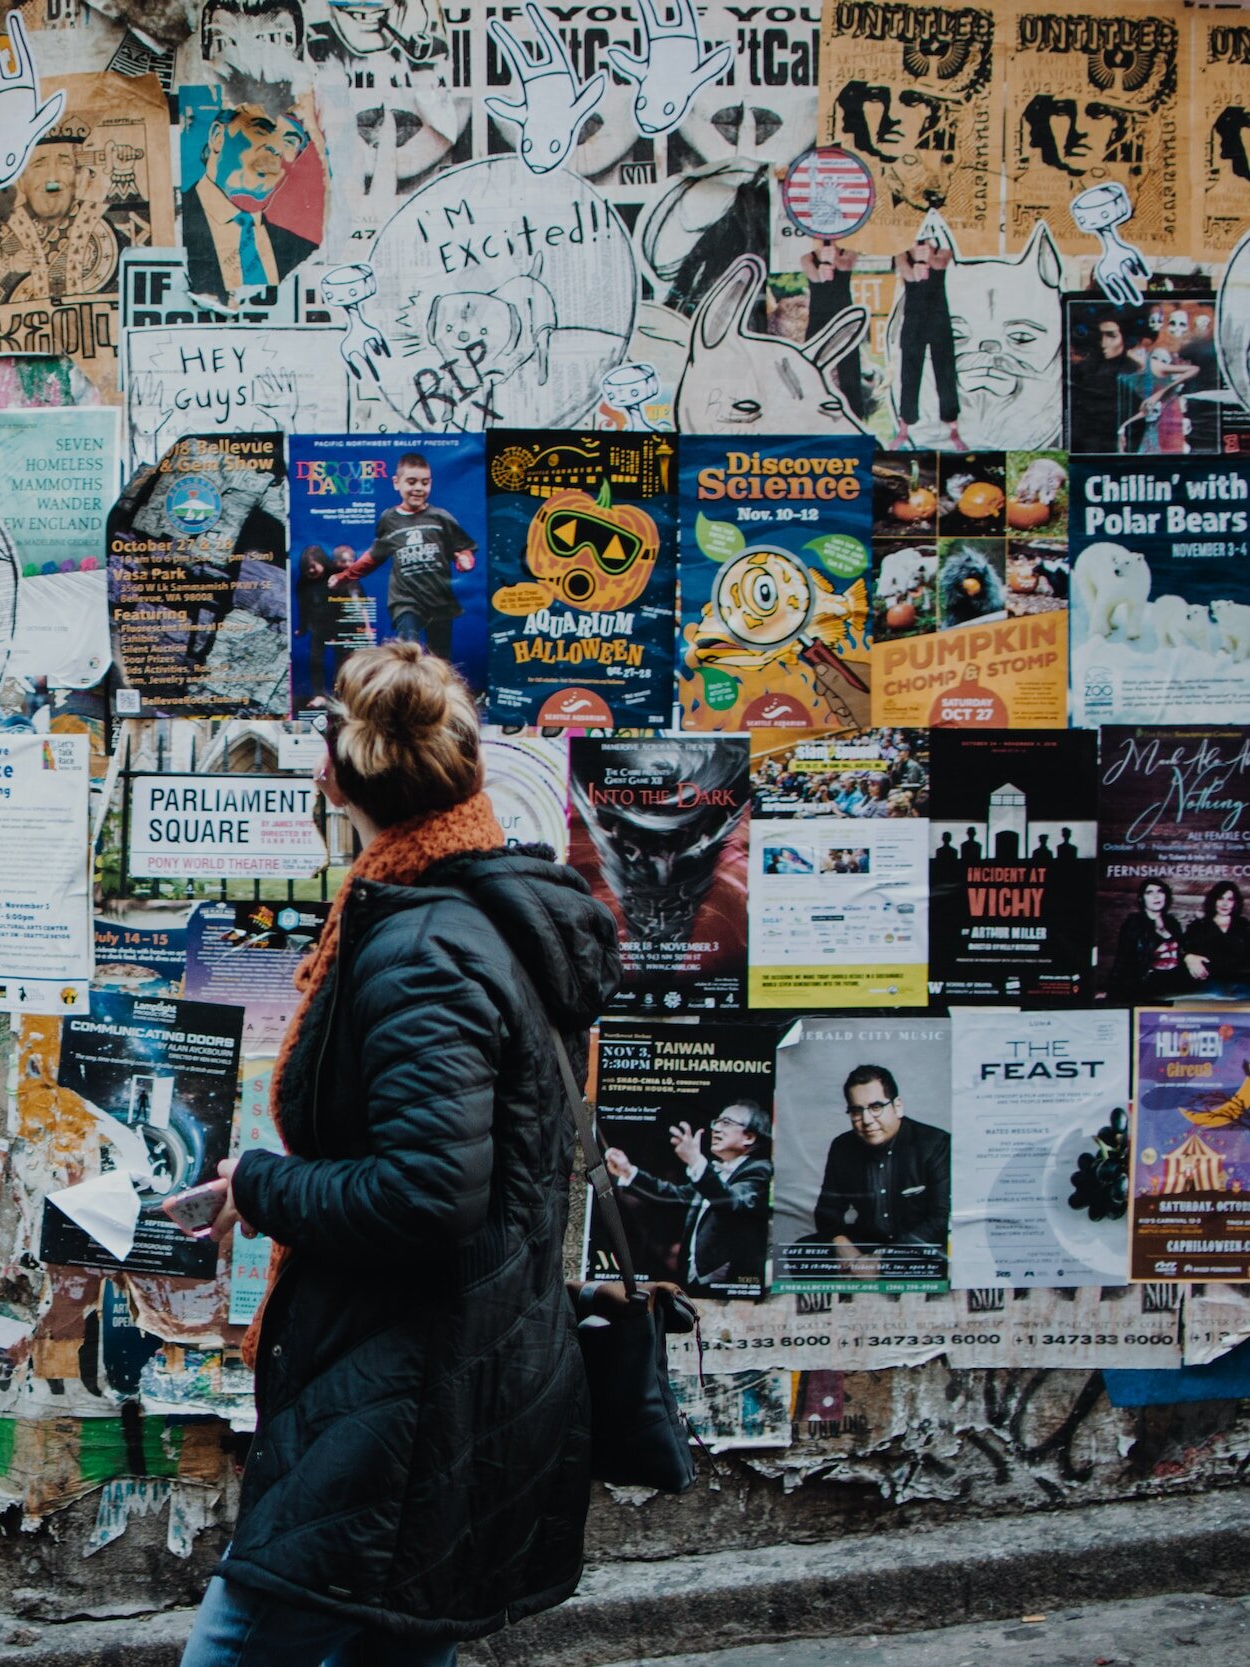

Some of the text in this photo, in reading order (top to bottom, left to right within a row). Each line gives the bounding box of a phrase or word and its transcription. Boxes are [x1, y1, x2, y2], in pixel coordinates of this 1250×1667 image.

[179, 343, 247, 375] HEY
[56, 438, 104, 451] SEVEN
[196, 439, 274, 455] Bellevue
[313, 439, 460, 448] PACIFIC NORTHWEST BALLET PRESENTS
[26, 458, 103, 472] HOMELESS
[160, 456, 275, 473] & Gem Show
[295, 460, 389, 480] DISCOVER
[726, 451, 860, 476] Discover
[11, 477, 103, 492] MAMMOTHS
[307, 477, 376, 496] DANCE
[697, 467, 861, 501] Science
[1084, 472, 1248, 503] Chillin' with
[37, 497, 102, 511] WANDER
[736, 506, 820, 522] Nov. 10-12
[1085, 505, 1248, 536] Polar Bears
[29, 517, 102, 530] ENGLAND
[111, 539, 195, 554] October 27
[1172, 542, 1226, 558] NOVEMBER
[113, 567, 187, 582] Vasa Park
[146, 581, 229, 593] W Sammamish
[165, 593, 183, 603] WA
[113, 608, 188, 623] Featuring
[522, 608, 636, 639] AQUARIUM
[121, 644, 188, 655] Silent Auction
[512, 636, 646, 667] HALLOWEEN
[883, 621, 1057, 676] PUMPKIN
[121, 655, 176, 665] Door Prizes
[883, 651, 1059, 697] CHOMP & STOMP
[1084, 685, 1114, 697] ZOO
[941, 698, 994, 707] SATURDAY
[941, 708, 994, 721] OCT 27
[150, 788, 311, 813] PARLIAMENT
[639, 789, 670, 805] THE
[676, 782, 738, 809] DARK
[149, 818, 249, 844] SQUARE
[261, 820, 270, 828] BY
[148, 857, 280, 870] PONY WORLD THEATRE
[967, 867, 1047, 883] INCIDENT AT
[5, 902, 45, 910] November
[967, 887, 1045, 918] VICHY
[971, 926, 1047, 940] ARTHUR MILLER
[660, 942, 712, 952] NOVEMBER
[133, 1000, 178, 1015] Lamplight
[70, 1020, 235, 1048] COMMUNICATING DOORS
[801, 1030, 945, 1041] ERALD CITY MUSIC
[168, 1043, 188, 1052] ALAN
[188, 1045, 234, 1057] AYCKBOURN
[603, 1046, 635, 1058] NOV
[654, 1041, 716, 1056] TAIWAN
[1005, 1040, 1071, 1058] THE
[602, 1058, 772, 1074] 7:30PM PHILHARMONIC
[980, 1060, 1105, 1081] FEAST
[608, 1084, 643, 1092] STEPHEN
[616, 1077, 661, 1085] SHAO-CHIA
[780, 1335, 832, 1347] 6000
[952, 1334, 1001, 1345] 6000
[1124, 1333, 1174, 1345] 6000
